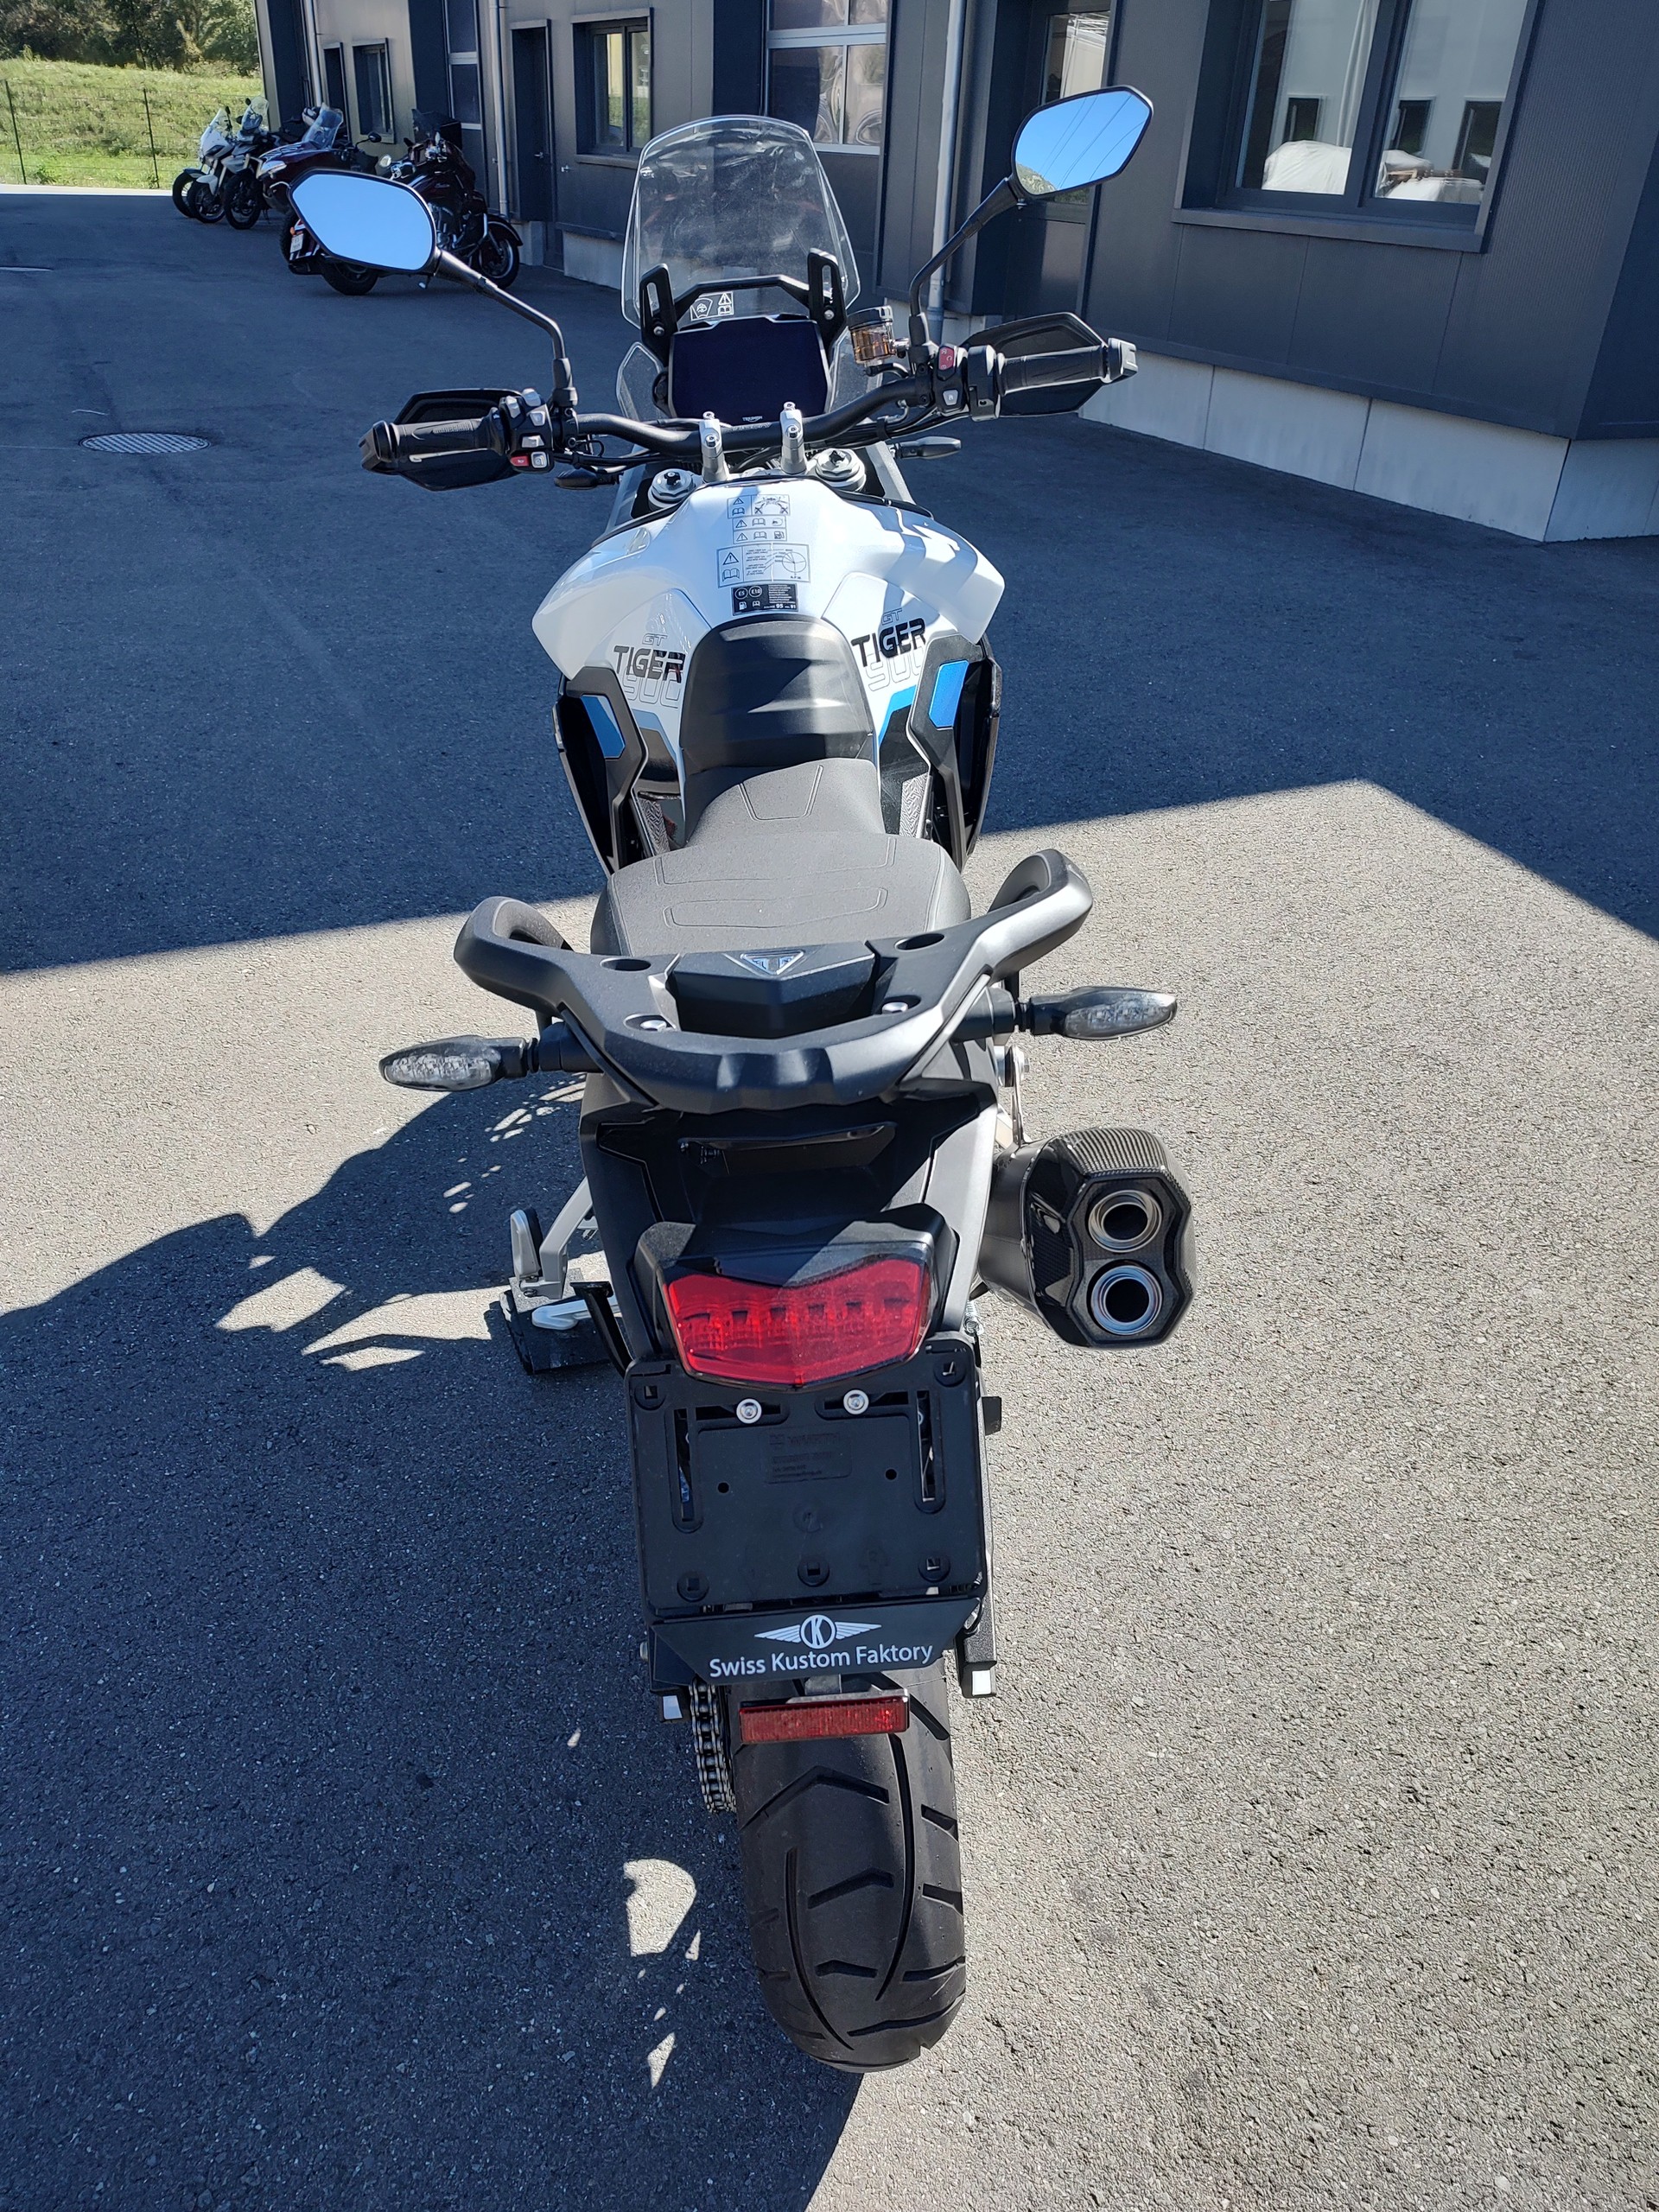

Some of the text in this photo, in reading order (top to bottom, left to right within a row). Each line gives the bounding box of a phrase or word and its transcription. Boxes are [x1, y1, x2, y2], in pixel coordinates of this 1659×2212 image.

[881, 607, 903, 626] GT
[642, 632, 668, 646] GT
[850, 618, 926, 668] TIGER
[613, 645, 686, 683] TIGER
[709, 1643, 933, 1677] Swiss Kustom Faktory
